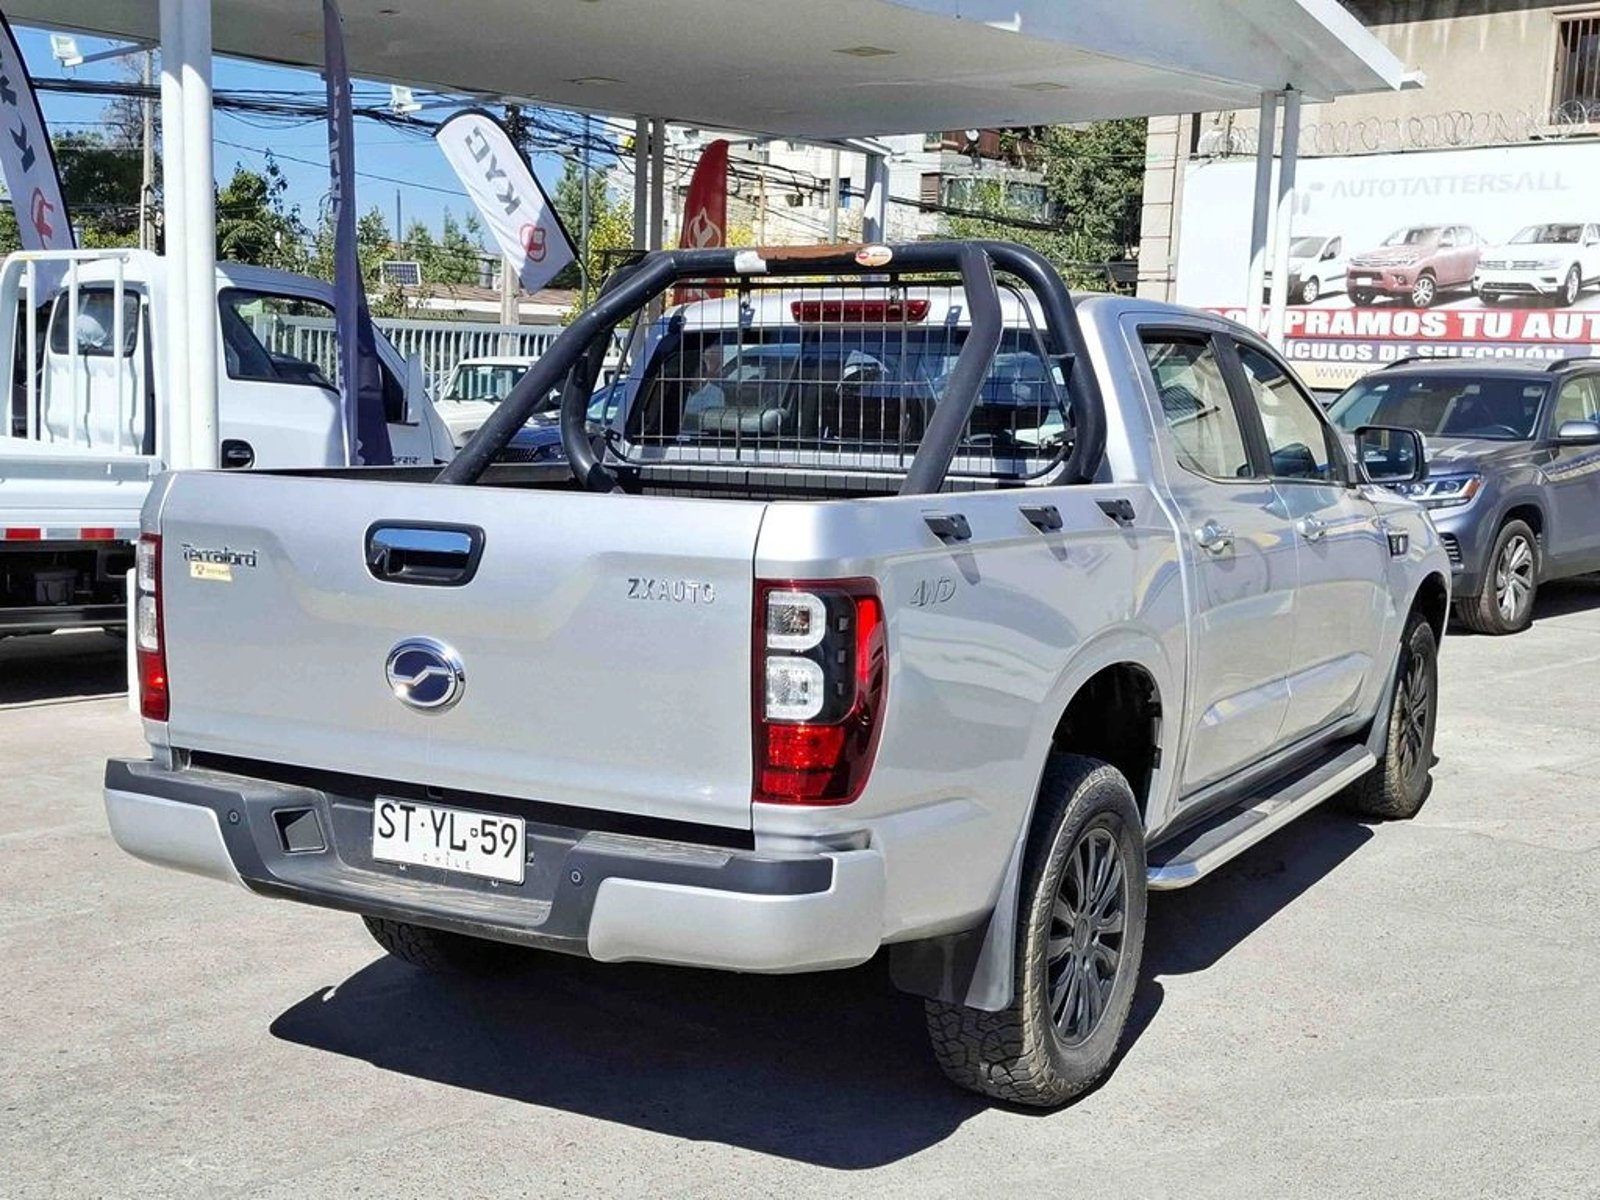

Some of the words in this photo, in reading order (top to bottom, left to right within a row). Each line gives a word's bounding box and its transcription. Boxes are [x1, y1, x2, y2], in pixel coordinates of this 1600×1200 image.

[1331, 171, 1570, 199] AUTOTATTERSALL
[1207, 309, 1448, 338] PRAMOS
[1457, 311, 1513, 339] TU
[1378, 343, 1412, 361] DE
[909, 577, 957, 608] 4WD
[422, 851, 472, 870] CHILE
